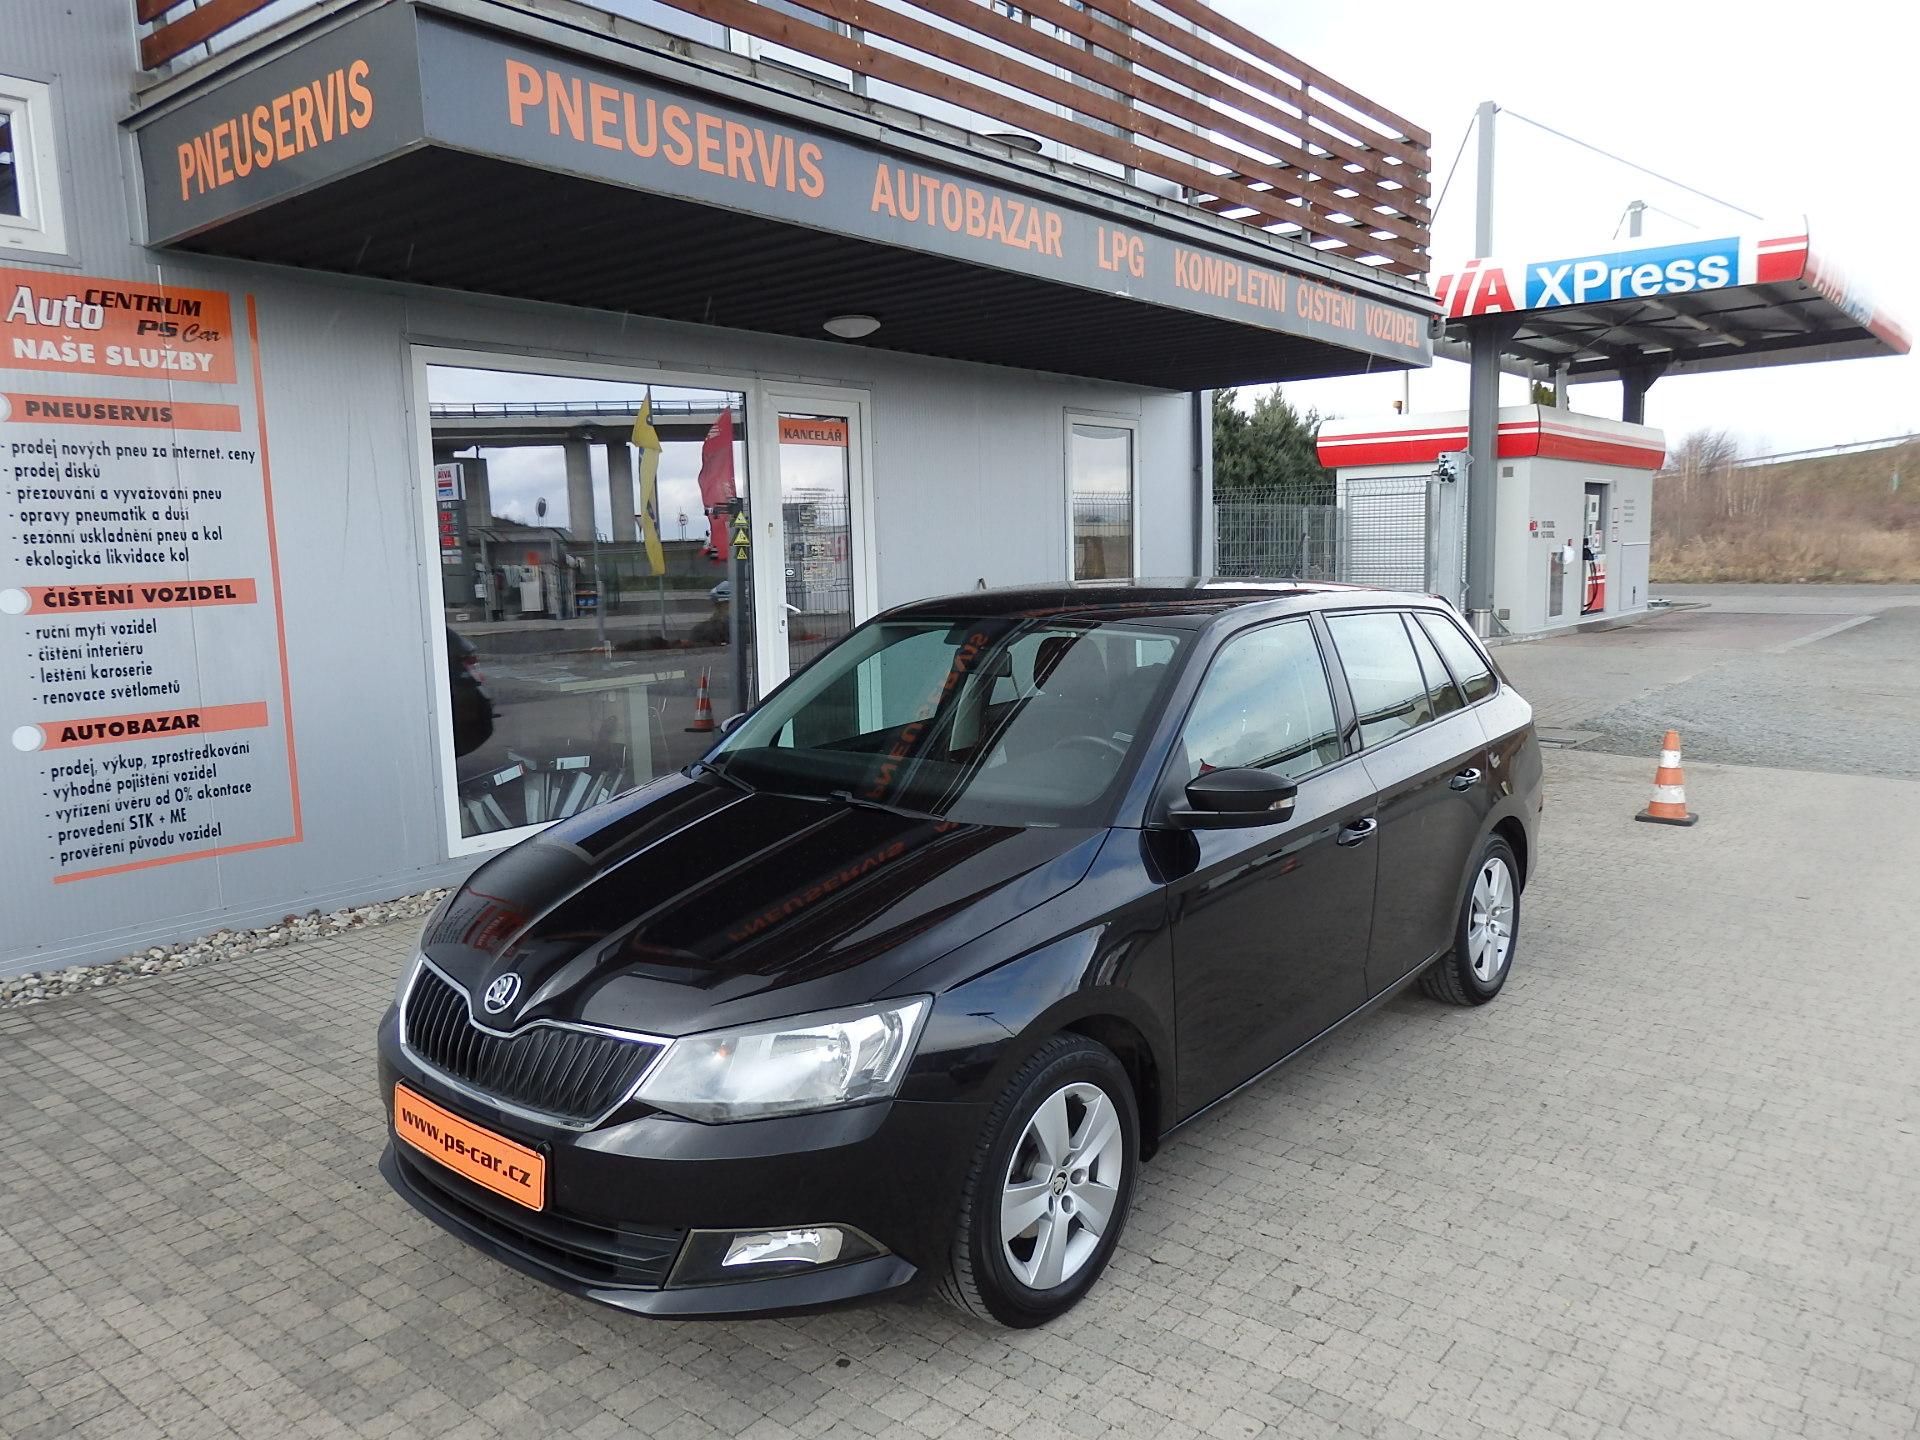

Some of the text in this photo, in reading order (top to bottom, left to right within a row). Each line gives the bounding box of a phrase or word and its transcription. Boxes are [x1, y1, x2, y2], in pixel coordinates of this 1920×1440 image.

[177, 59, 374, 201] PNEUSERVIS
[505, 59, 1420, 348] PNEUSERVIS AUTOBAZAR LPG KOMPLETNÍ ČIŠTĚNÍ VOZIDEL
[4, 285, 105, 331] Auto
[85, 288, 202, 317] CENTRUM
[137, 319, 178, 338] PS
[12, 335, 214, 372] NAŠE SLUŽBY
[25, 400, 174, 423] PNEUSERVIS
[784, 428, 842, 441] KANCELÁŘ
[12, 438, 256, 464] prodej nových pneu za internet. ceny
[15, 462, 60, 482] prodej
[100, 488, 109, 500] a
[192, 489, 222, 503] pneu
[20, 510, 70, 526] opravy
[75, 506, 147, 526] pneumatik
[152, 510, 160, 521] a
[156, 529, 188, 546] pneu
[191, 530, 199, 541] a
[203, 525, 223, 541] kol
[106, 548, 166, 565] likvidace
[170, 547, 189, 562] kol
[43, 584, 237, 608] ČIŠTĚNÍ VOZIDEL
[36, 623, 71, 640] ruční
[110, 617, 157, 636] vozidel
[38, 640, 144, 662] čištění interiéru
[40, 660, 153, 684] leštění karoserie
[43, 679, 181, 705] renovace světlometů
[60, 713, 201, 743] AUTOBAZAR
[51, 758, 98, 782] prodej,
[174, 763, 217, 782] vozidel
[155, 790, 171, 806] od
[174, 786, 193, 802] 0%
[196, 782, 252, 800] akontace
[58, 818, 125, 845] provedení
[129, 813, 155, 830] STK
[170, 807, 187, 824] ME
[129, 831, 175, 854] původu
[178, 822, 222, 841] vozidel
[401, 1107, 532, 1188] www.ps-car.cz
